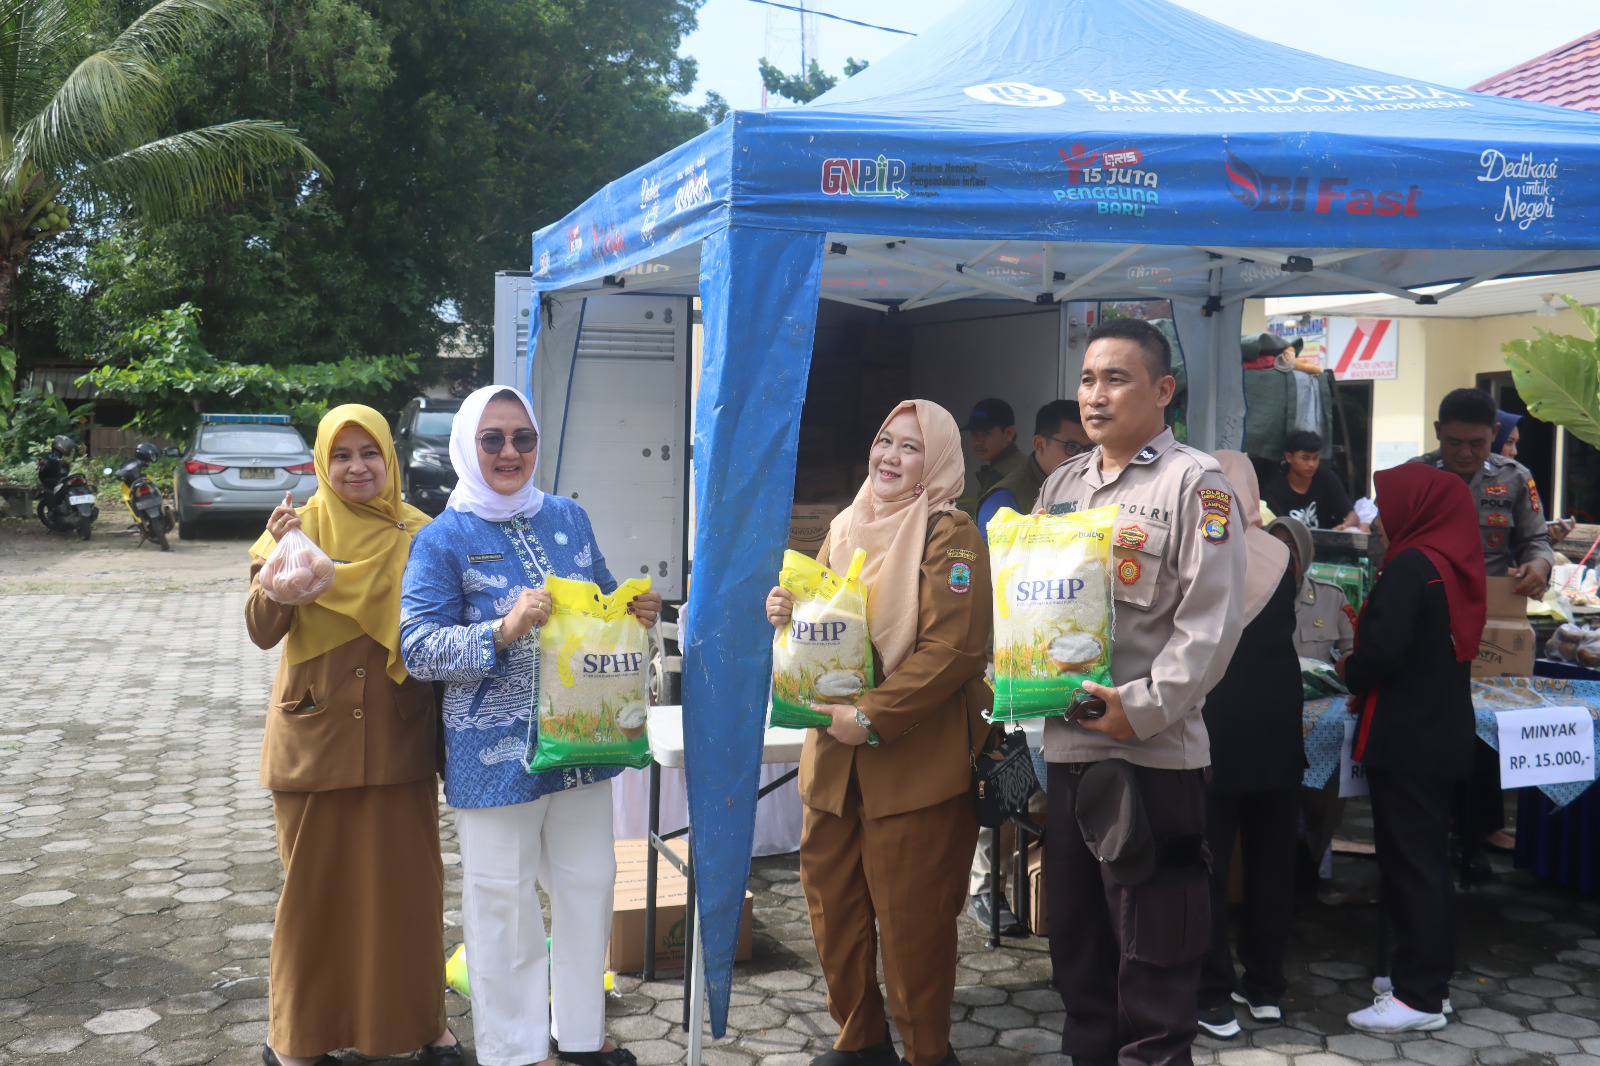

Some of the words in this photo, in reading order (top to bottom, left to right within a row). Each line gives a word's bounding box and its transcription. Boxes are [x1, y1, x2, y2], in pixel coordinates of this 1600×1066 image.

[1073, 88, 1208, 104] BANK
[1205, 85, 1465, 104] INDONESIA
[1094, 104, 1158, 113] BANK
[1257, 105, 1359, 113] REPUBLIK
[1358, 100, 1475, 112] INDONESIA
[945, 163, 977, 173] Nasional
[1477, 149, 1559, 181] Dedikasi
[1082, 168, 1102, 183] 15
[1106, 168, 1158, 189] JUTA
[1522, 179, 1550, 196] untuk
[1251, 175, 1310, 212] BI
[1315, 177, 1424, 217] Fast
[1097, 201, 1146, 217] BARU
[1495, 195, 1556, 230] Negeri
[1350, 362, 1369, 370] POLRI
[1370, 361, 1394, 369] UNTUK
[1350, 369, 1395, 378] MASYARAKAT
[1016, 578, 1085, 602] SPHP
[583, 652, 643, 674] SPHP
[1030, 664, 1038, 677] 5
[594, 732, 601, 743] 5
[1521, 722, 1577, 740] MINYAK
[1510, 755, 1530, 770] RP.
[1535, 750, 1591, 767] 15.000,-
